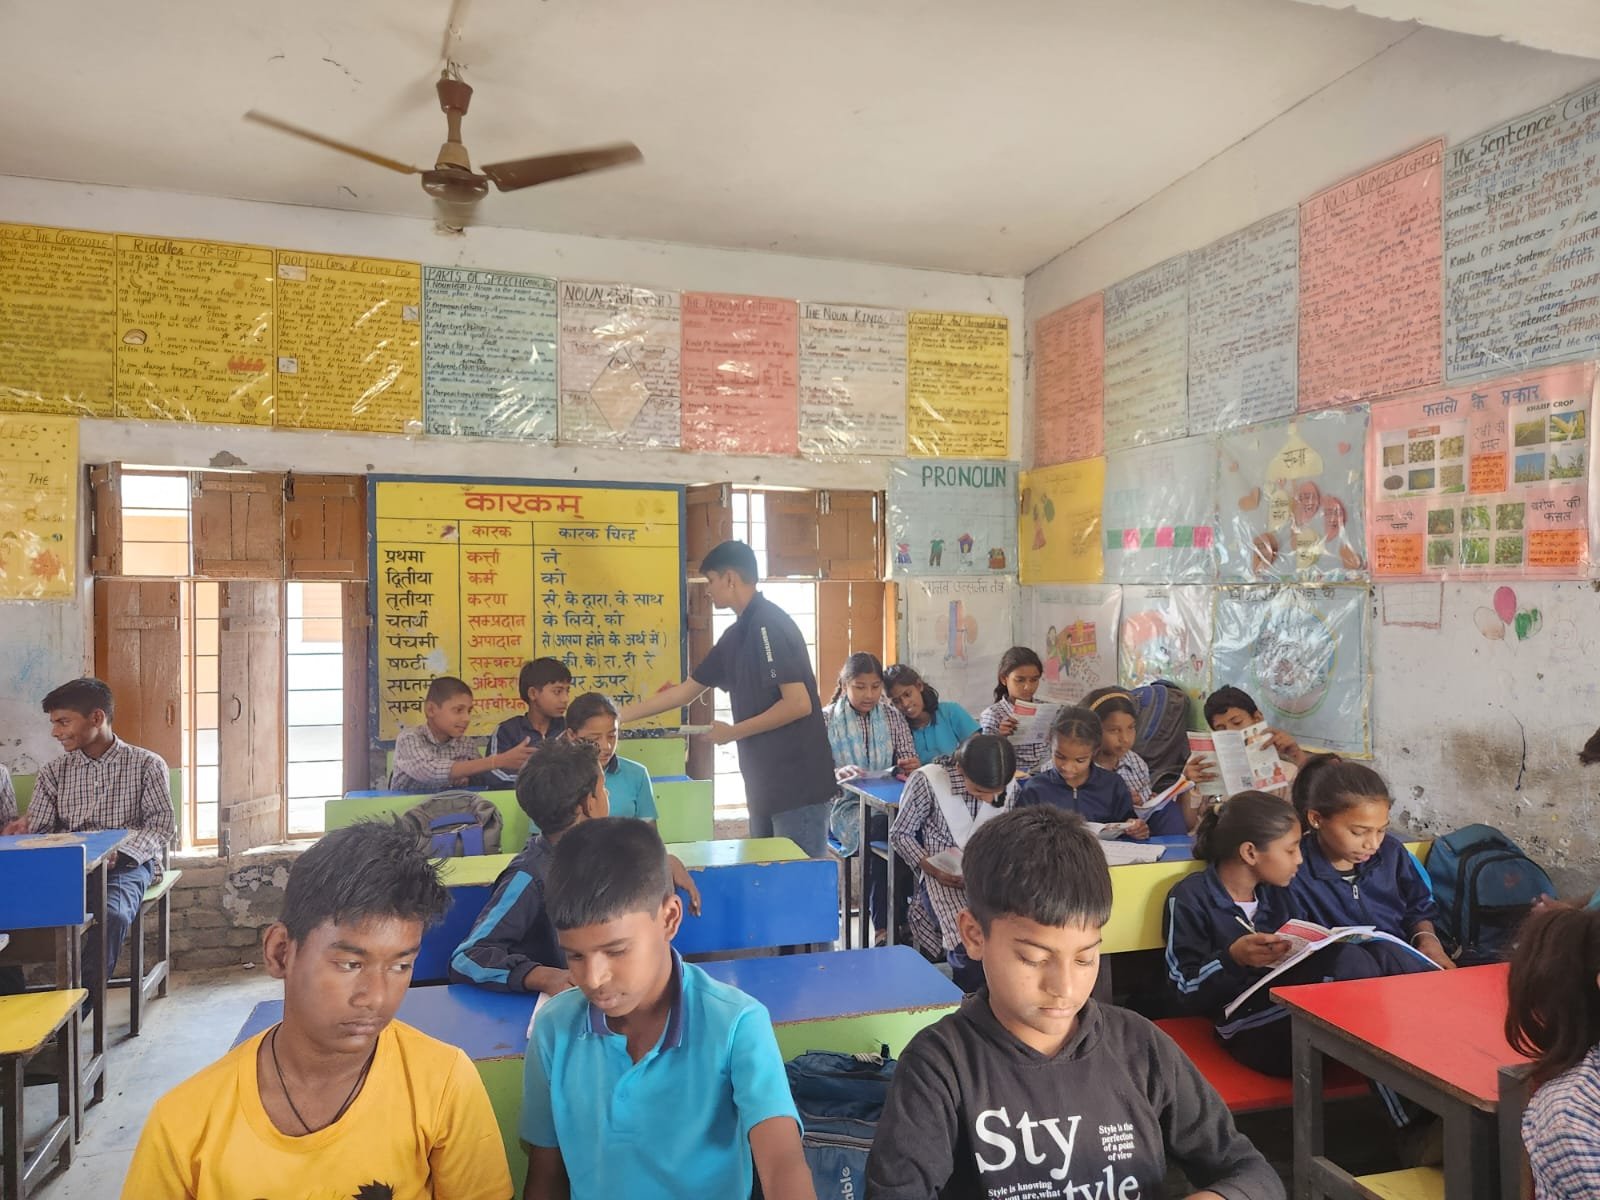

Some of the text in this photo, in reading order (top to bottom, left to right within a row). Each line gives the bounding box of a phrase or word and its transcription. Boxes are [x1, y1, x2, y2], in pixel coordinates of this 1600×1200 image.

[1454, 148, 1474, 168] The
[1480, 114, 1556, 156] Sentence
[134, 239, 184, 256] Riddles
[1450, 252, 1475, 269] Kinds
[1560, 218, 1568, 230] 5
[428, 268, 462, 282] PARTS
[1454, 262, 1511, 286] Affirmative
[1514, 248, 1552, 266] Sentence
[1469, 273, 1505, 290] mother
[565, 284, 604, 301] NOUN
[805, 305, 820, 319] THE
[823, 306, 848, 321] NOUN
[1532, 339, 1562, 357] passed
[1567, 336, 1581, 346] the
[1553, 400, 1574, 409] CROP
[28, 472, 49, 486] THE
[922, 465, 1006, 488] PRONOUN
[464, 490, 584, 519] कारकम्
[472, 524, 512, 539] कारक
[558, 524, 637, 543] कारक चिन्ह
[385, 549, 426, 564] प्रथमा
[468, 571, 497, 587] कर्म
[541, 568, 567, 585] को
[385, 590, 434, 610] तृतीया
[467, 593, 507, 607] करण
[564, 591, 579, 606] के
[614, 590, 628, 606] के
[633, 594, 664, 607] साथ
[467, 614, 526, 631] सम्प्रदान
[541, 611, 558, 626] के
[604, 610, 625, 626] को
[468, 634, 522, 650] अपादान
[608, 630, 621, 646] के
[625, 630, 647, 646] अर्थ
[1098, 1124, 1117, 1135] Style
[1123, 1122, 1134, 1131] the
[975, 1106, 1082, 1180] Sty
[1103, 1143, 1112, 1152] of
[1107, 1152, 1133, 1161] of view
[988, 1181, 1053, 1198] Style is knowing
